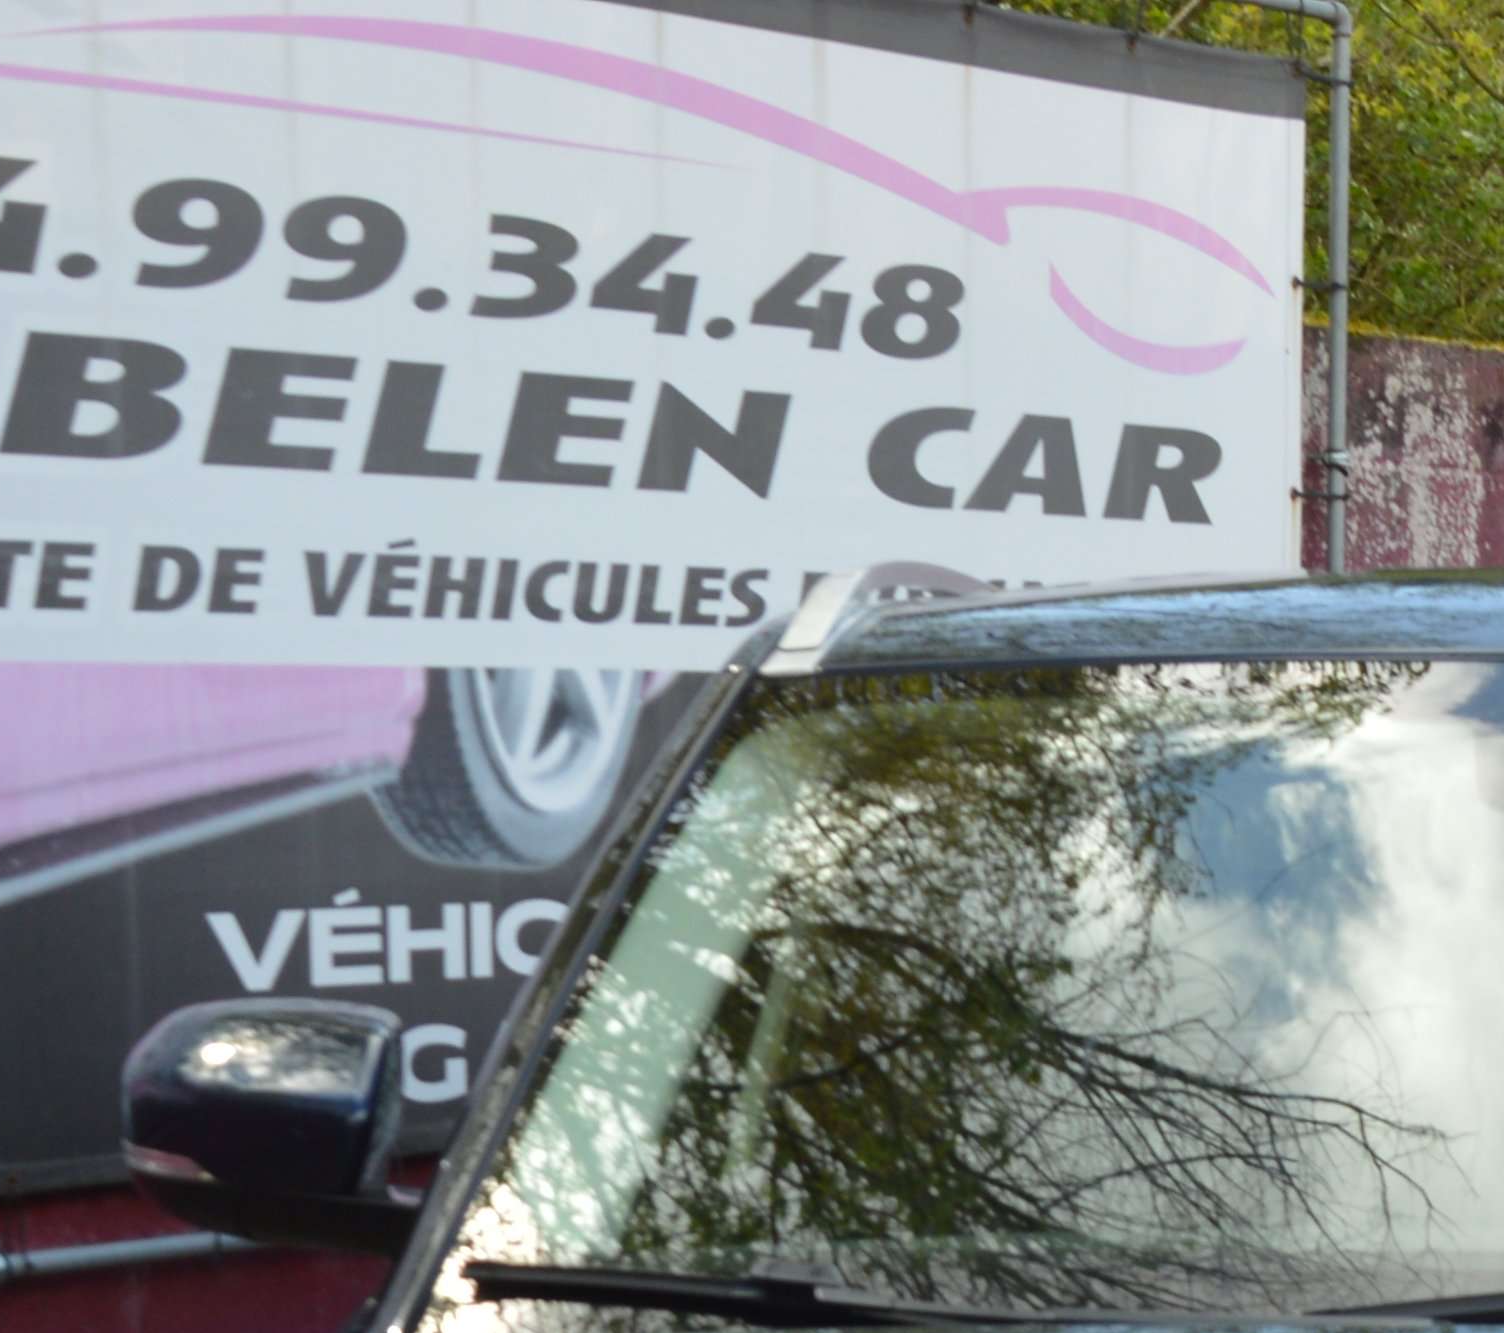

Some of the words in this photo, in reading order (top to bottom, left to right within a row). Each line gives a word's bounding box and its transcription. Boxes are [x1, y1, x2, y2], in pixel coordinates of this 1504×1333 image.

[866, 406, 1225, 525] CAR
[132, 545, 265, 615] DE
[304, 539, 769, 628] VÉHICULES
